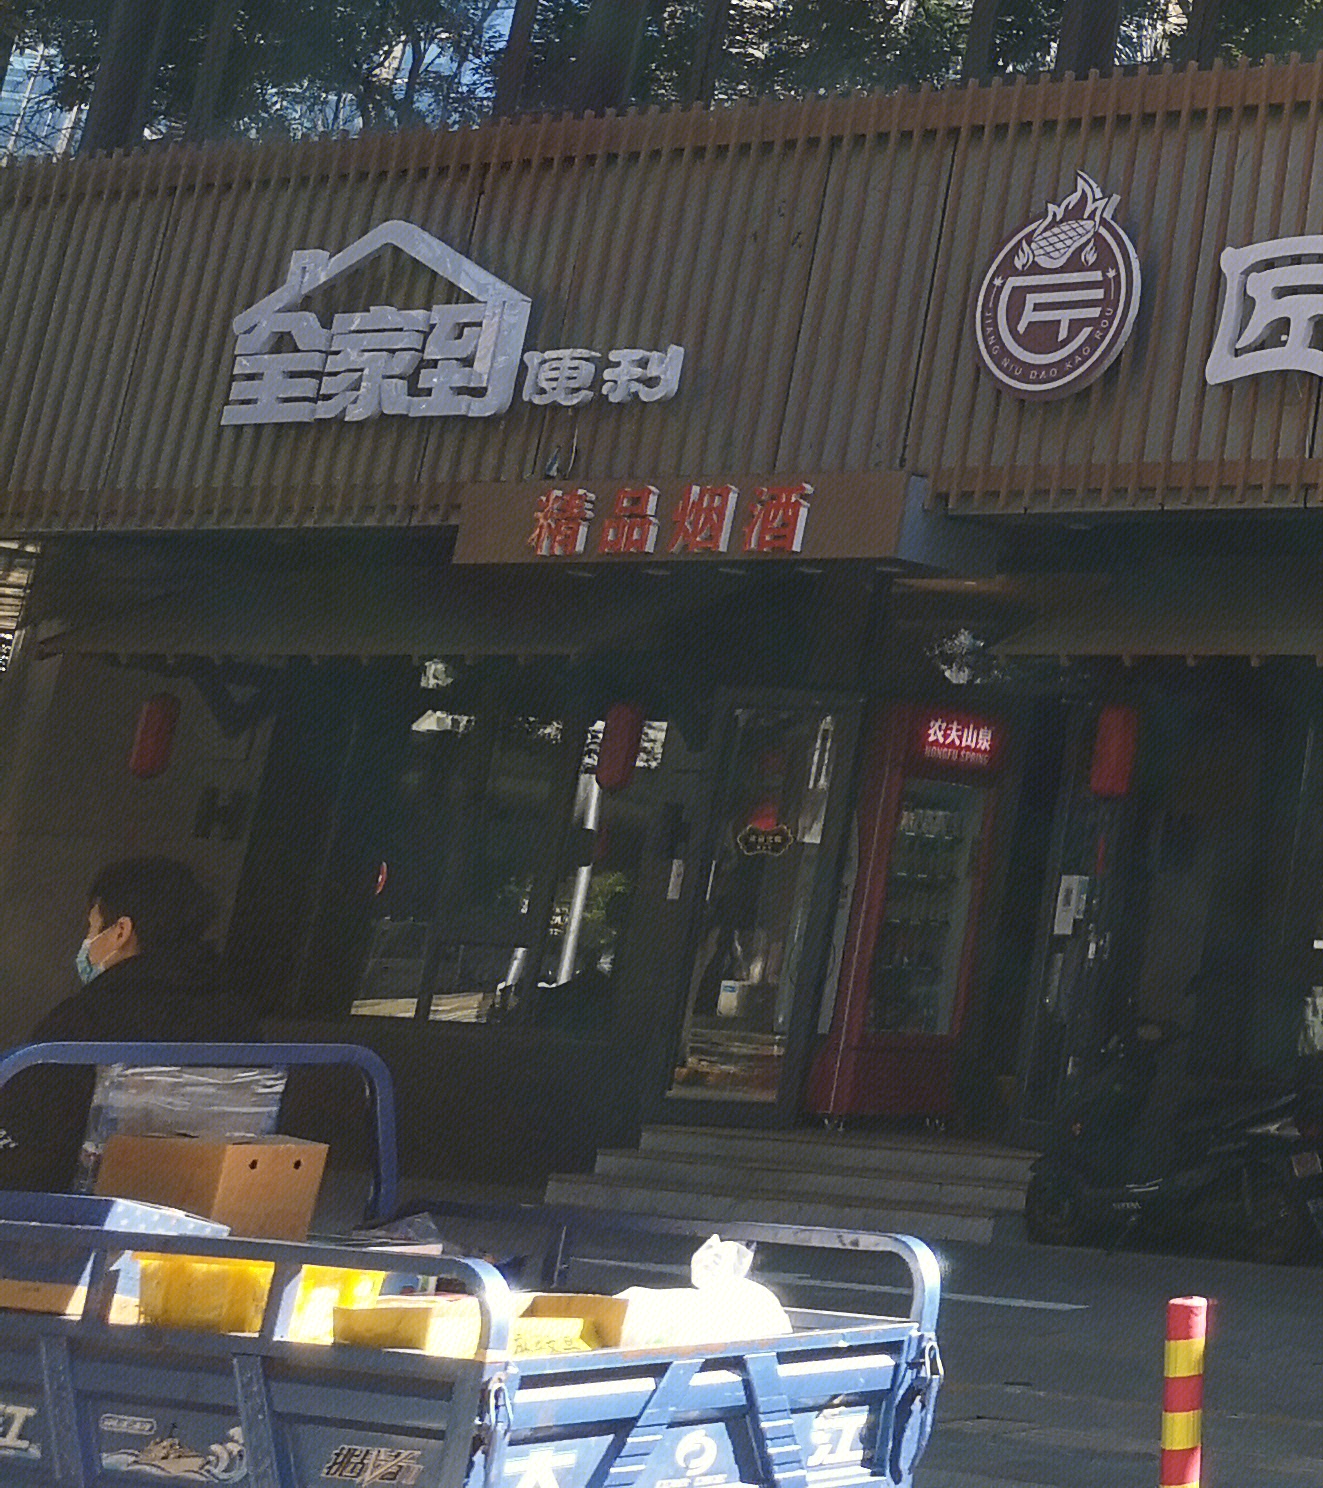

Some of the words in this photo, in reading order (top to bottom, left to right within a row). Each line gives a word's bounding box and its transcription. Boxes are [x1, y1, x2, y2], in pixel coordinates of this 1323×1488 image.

[984, 311, 1000, 355] JIANG
[1001, 356, 1023, 377] NIU
[1029, 367, 1058, 380] DAO
[1065, 346, 1091, 370] KAO
[1094, 307, 1113, 340] ROU
[534, 482, 815, 557] 精品烟酒
[928, 717, 993, 751] 农夫山泉
